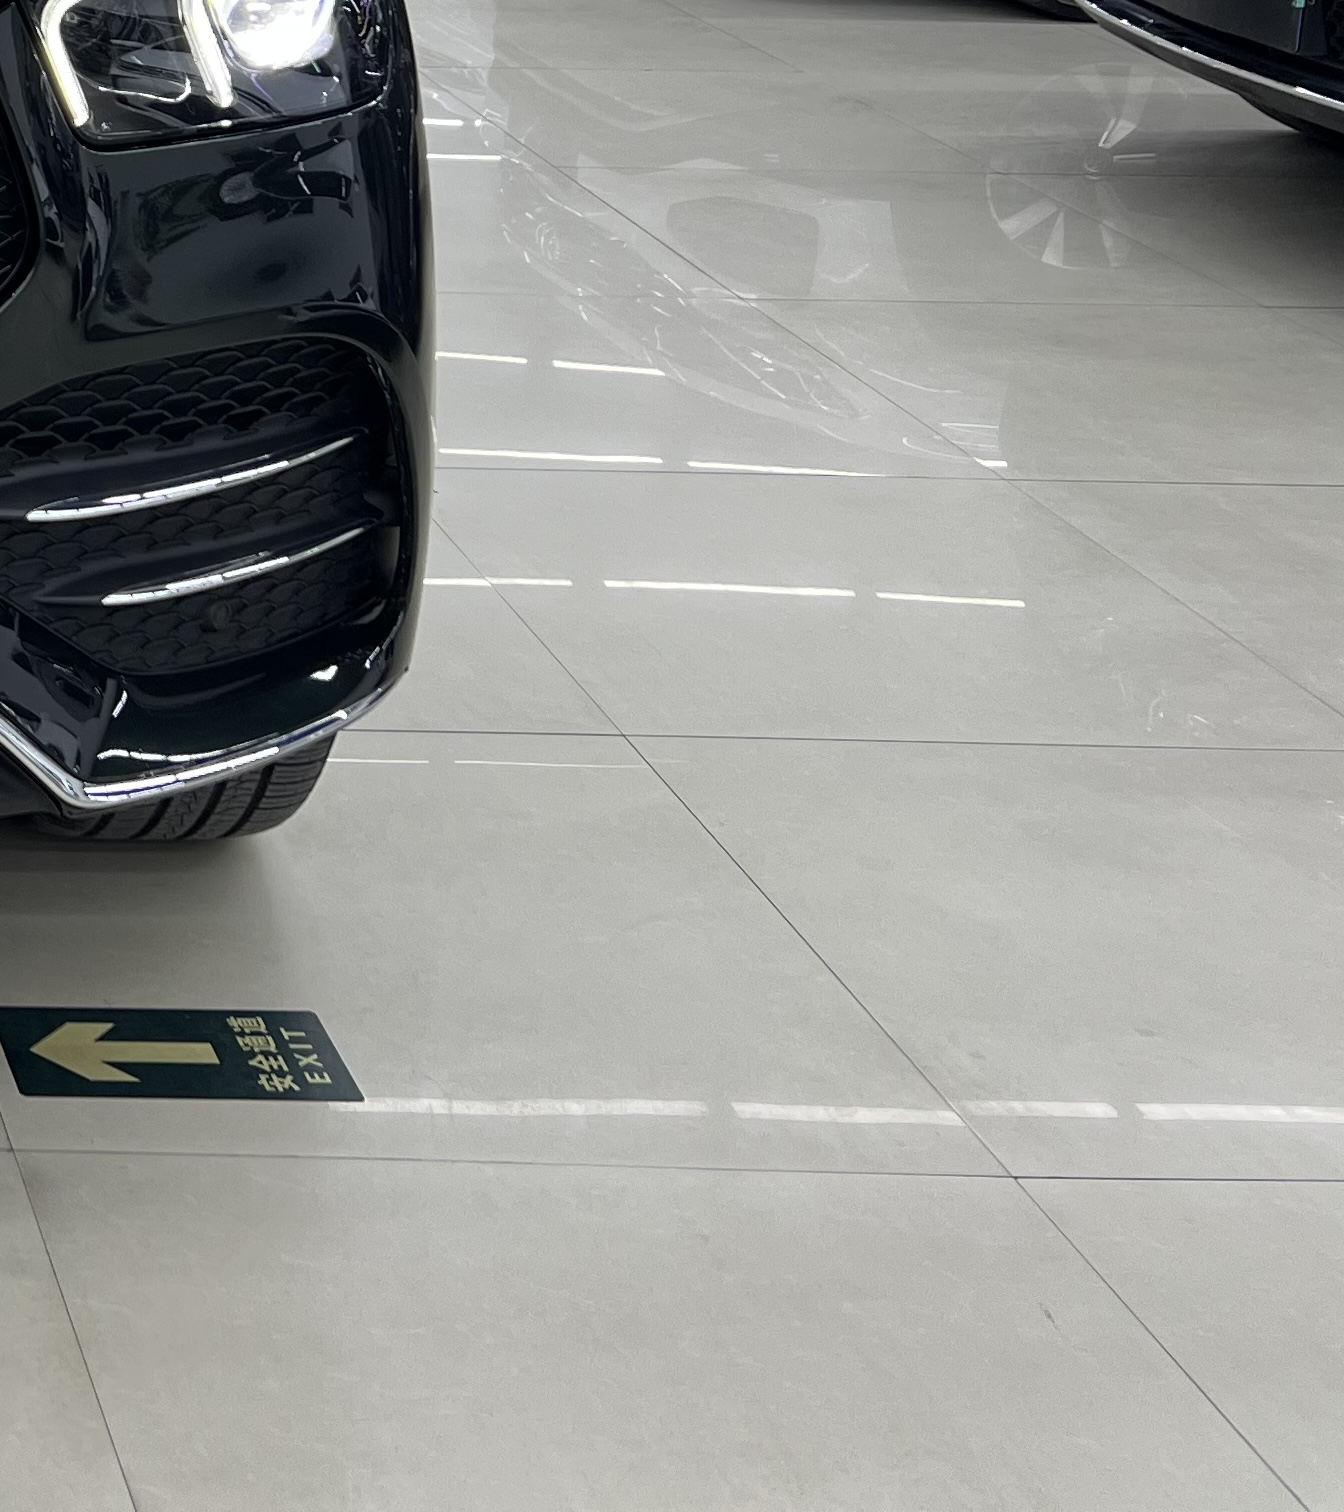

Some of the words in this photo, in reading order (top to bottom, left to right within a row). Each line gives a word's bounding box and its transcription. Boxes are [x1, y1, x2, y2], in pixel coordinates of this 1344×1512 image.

[226, 1015, 301, 1093] 安全通道
[279, 1026, 333, 1084] EXIT
